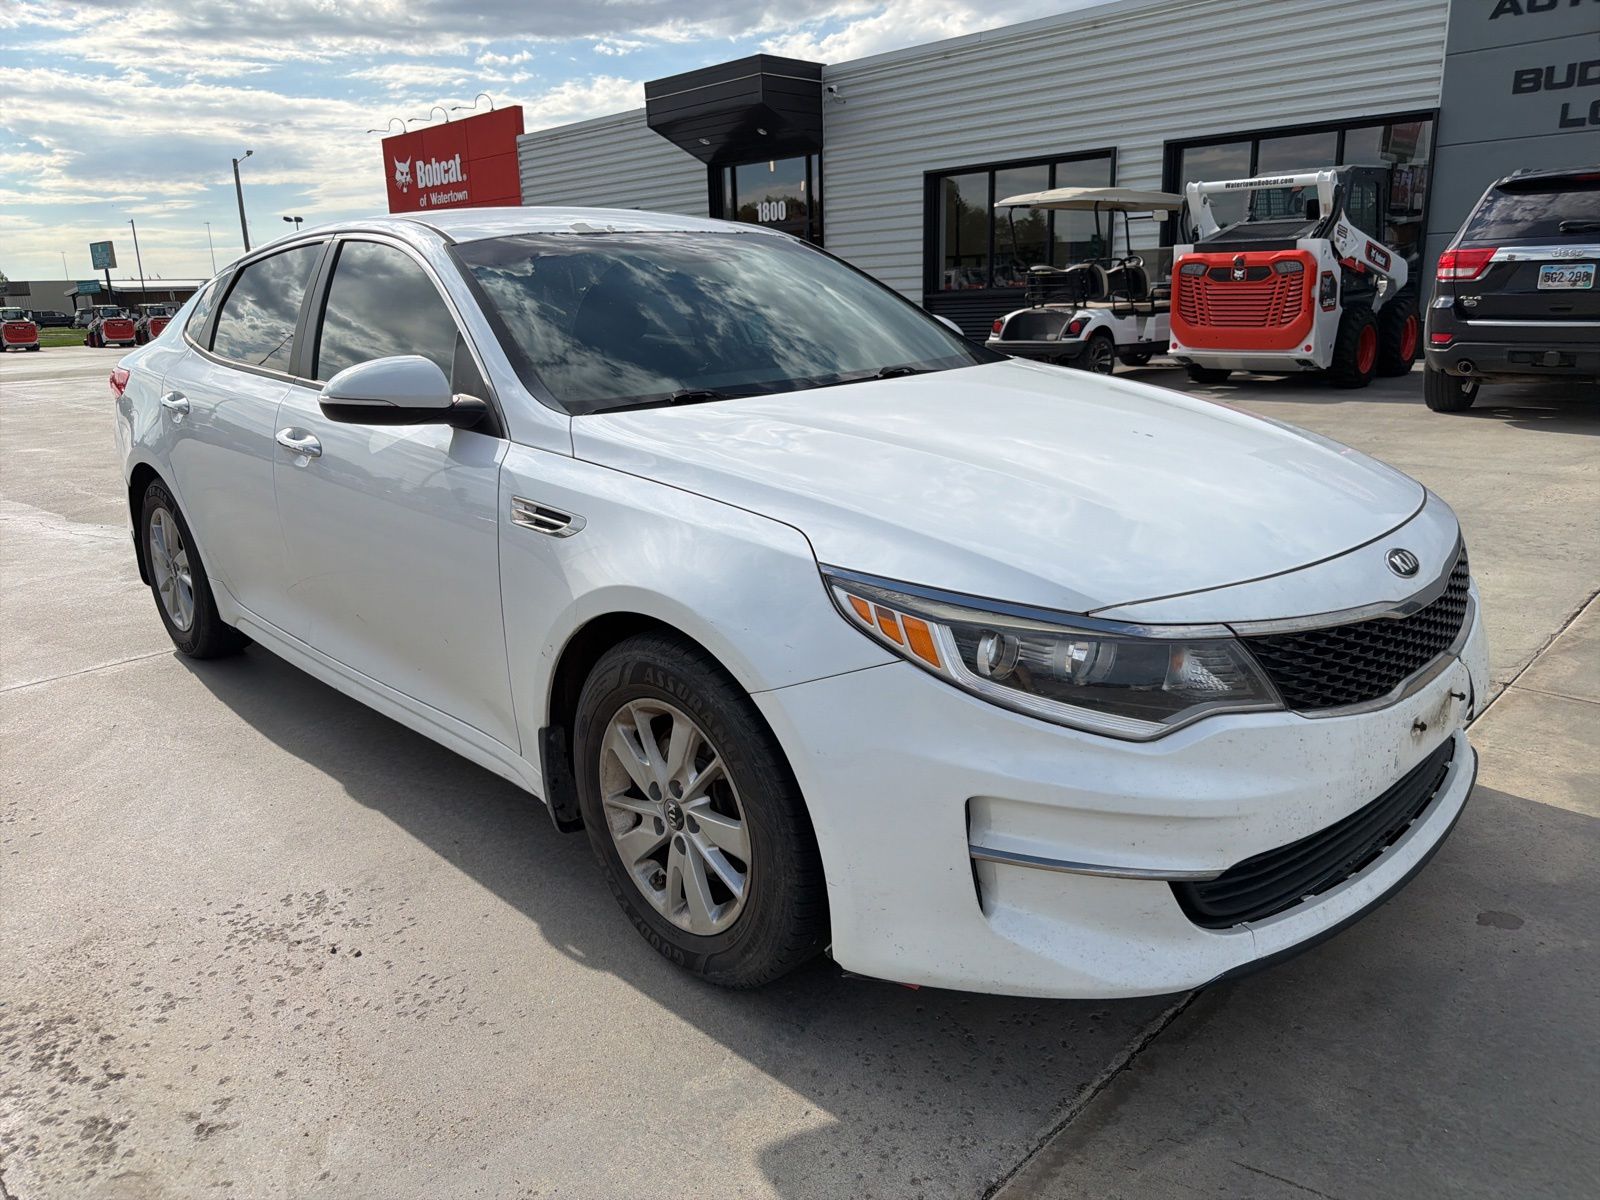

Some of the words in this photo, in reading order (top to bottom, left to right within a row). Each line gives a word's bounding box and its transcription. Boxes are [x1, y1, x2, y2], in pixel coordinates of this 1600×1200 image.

[1488, 0, 1600, 20] AU
[420, 193, 427, 207] of
[430, 190, 468, 206] Watertown
[756, 200, 786, 222] 1800
